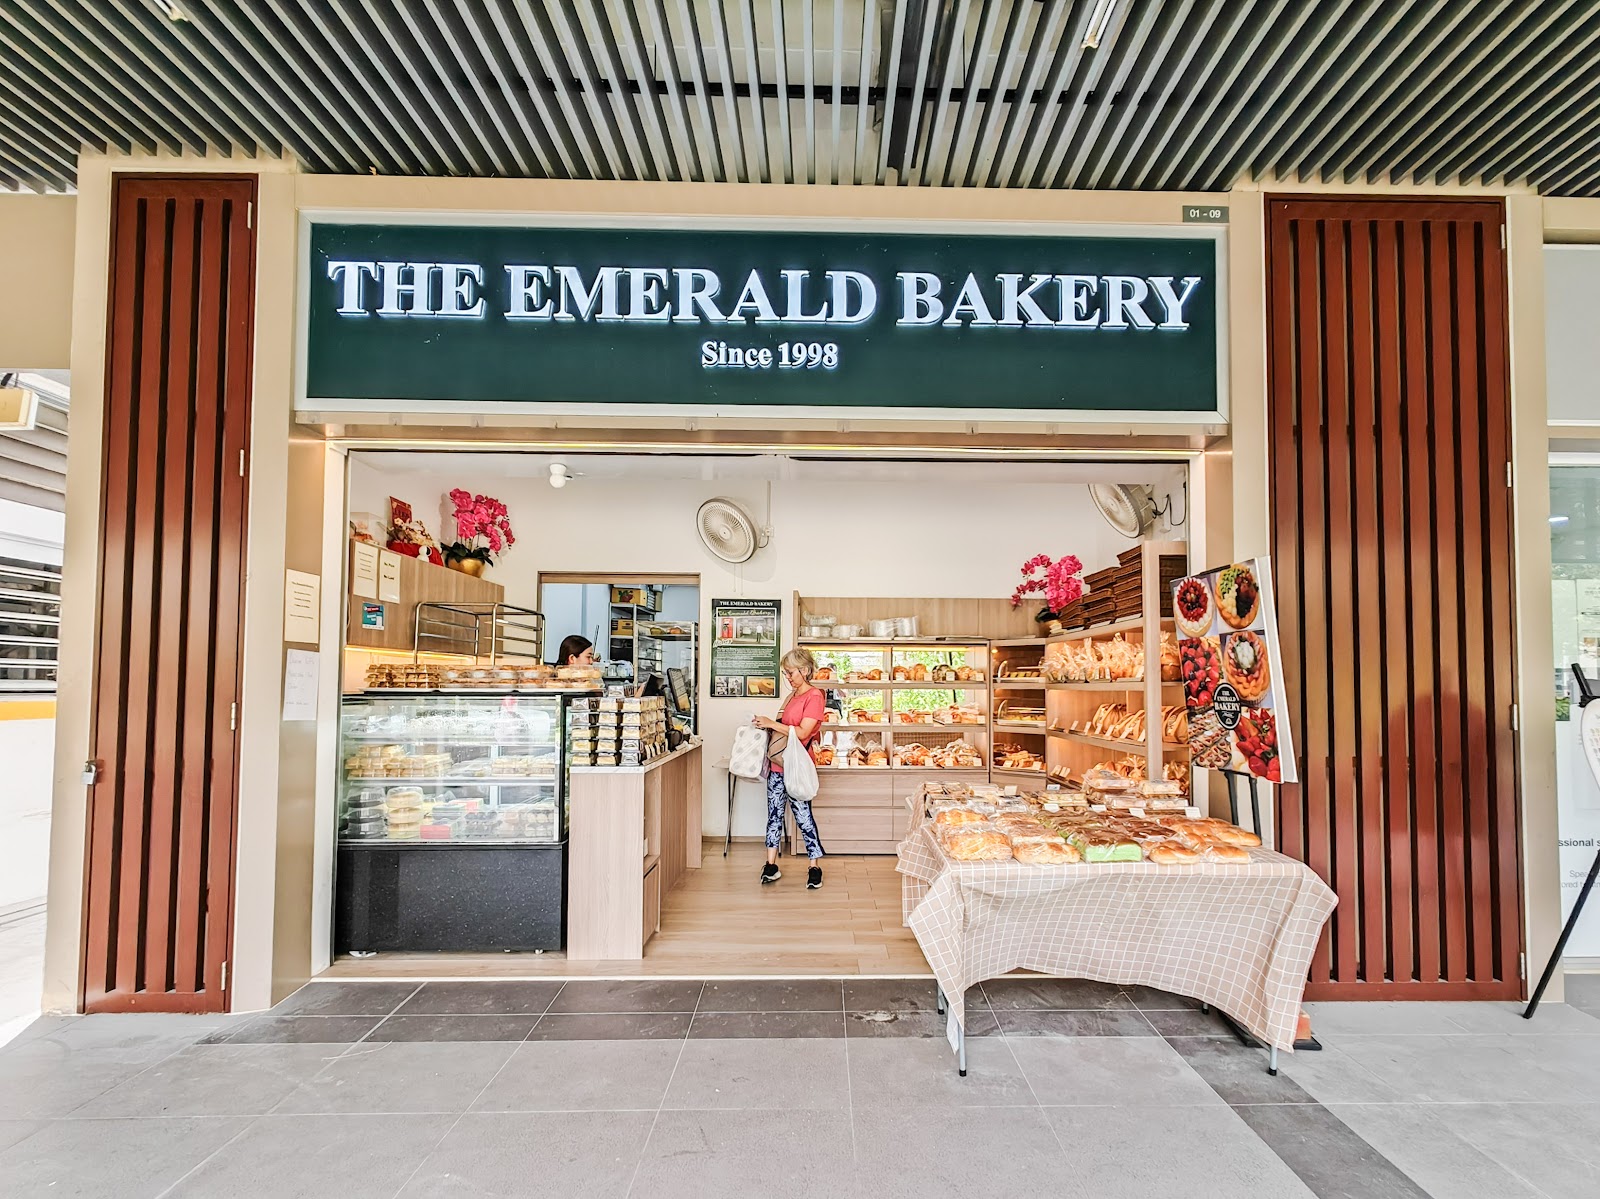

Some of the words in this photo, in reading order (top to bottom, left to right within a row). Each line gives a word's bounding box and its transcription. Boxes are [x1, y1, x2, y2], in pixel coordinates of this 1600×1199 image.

[1189, 209, 1200, 218] 01
[1209, 209, 1221, 218] 09
[327, 260, 486, 319] THE
[503, 264, 877, 325] EMERALD
[895, 272, 1201, 331] BAKERY
[702, 341, 773, 369] Since
[777, 342, 839, 369] 1998
[1215, 702, 1241, 711] BAKERY
